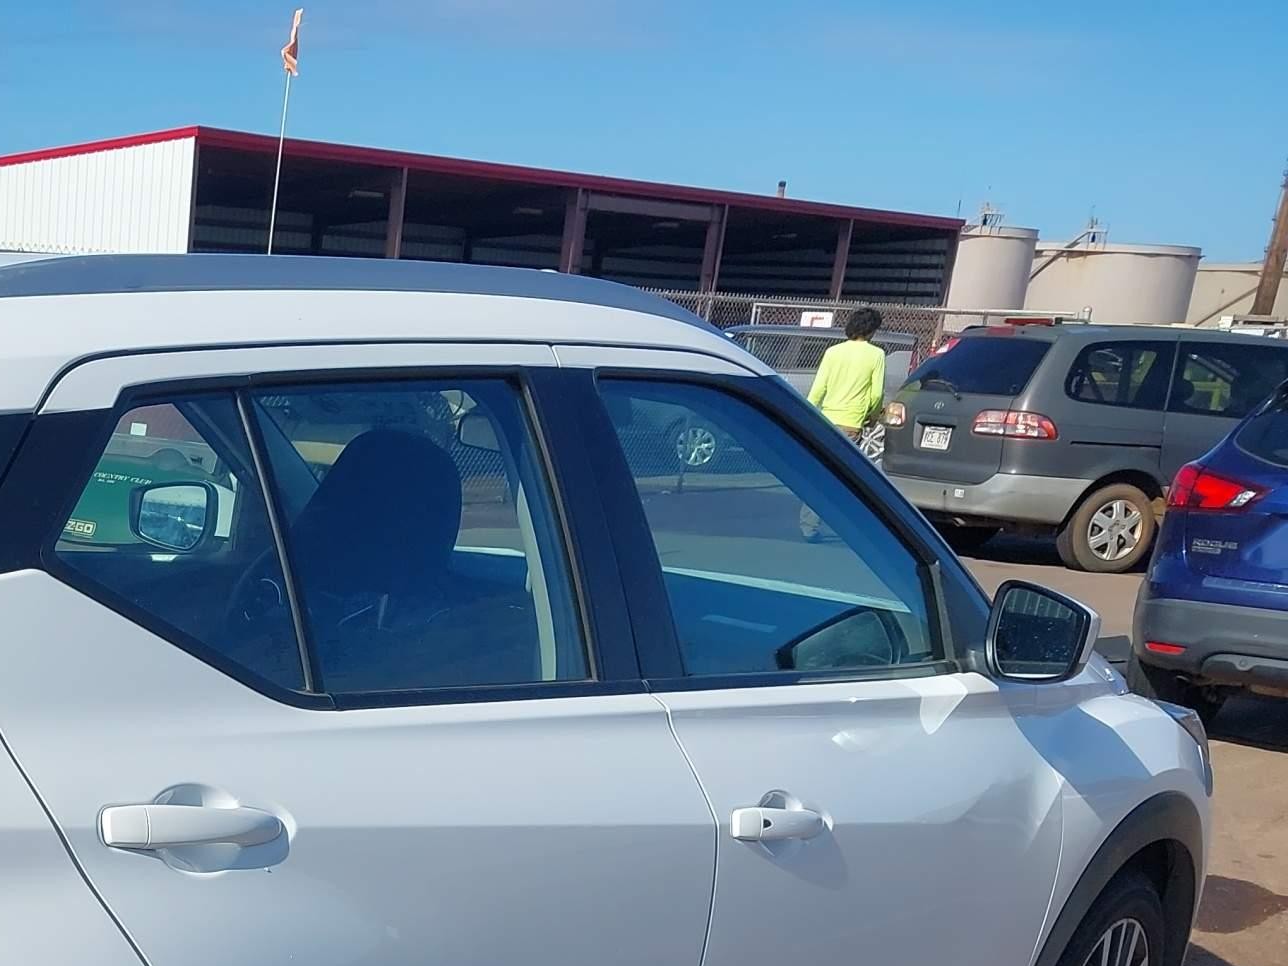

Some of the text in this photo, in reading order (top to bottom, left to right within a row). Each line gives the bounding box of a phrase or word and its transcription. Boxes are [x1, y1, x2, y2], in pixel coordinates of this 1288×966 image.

[94, 471, 152, 485] COUNTRY CLUB
[1192, 537, 1238, 550] ROGUE
